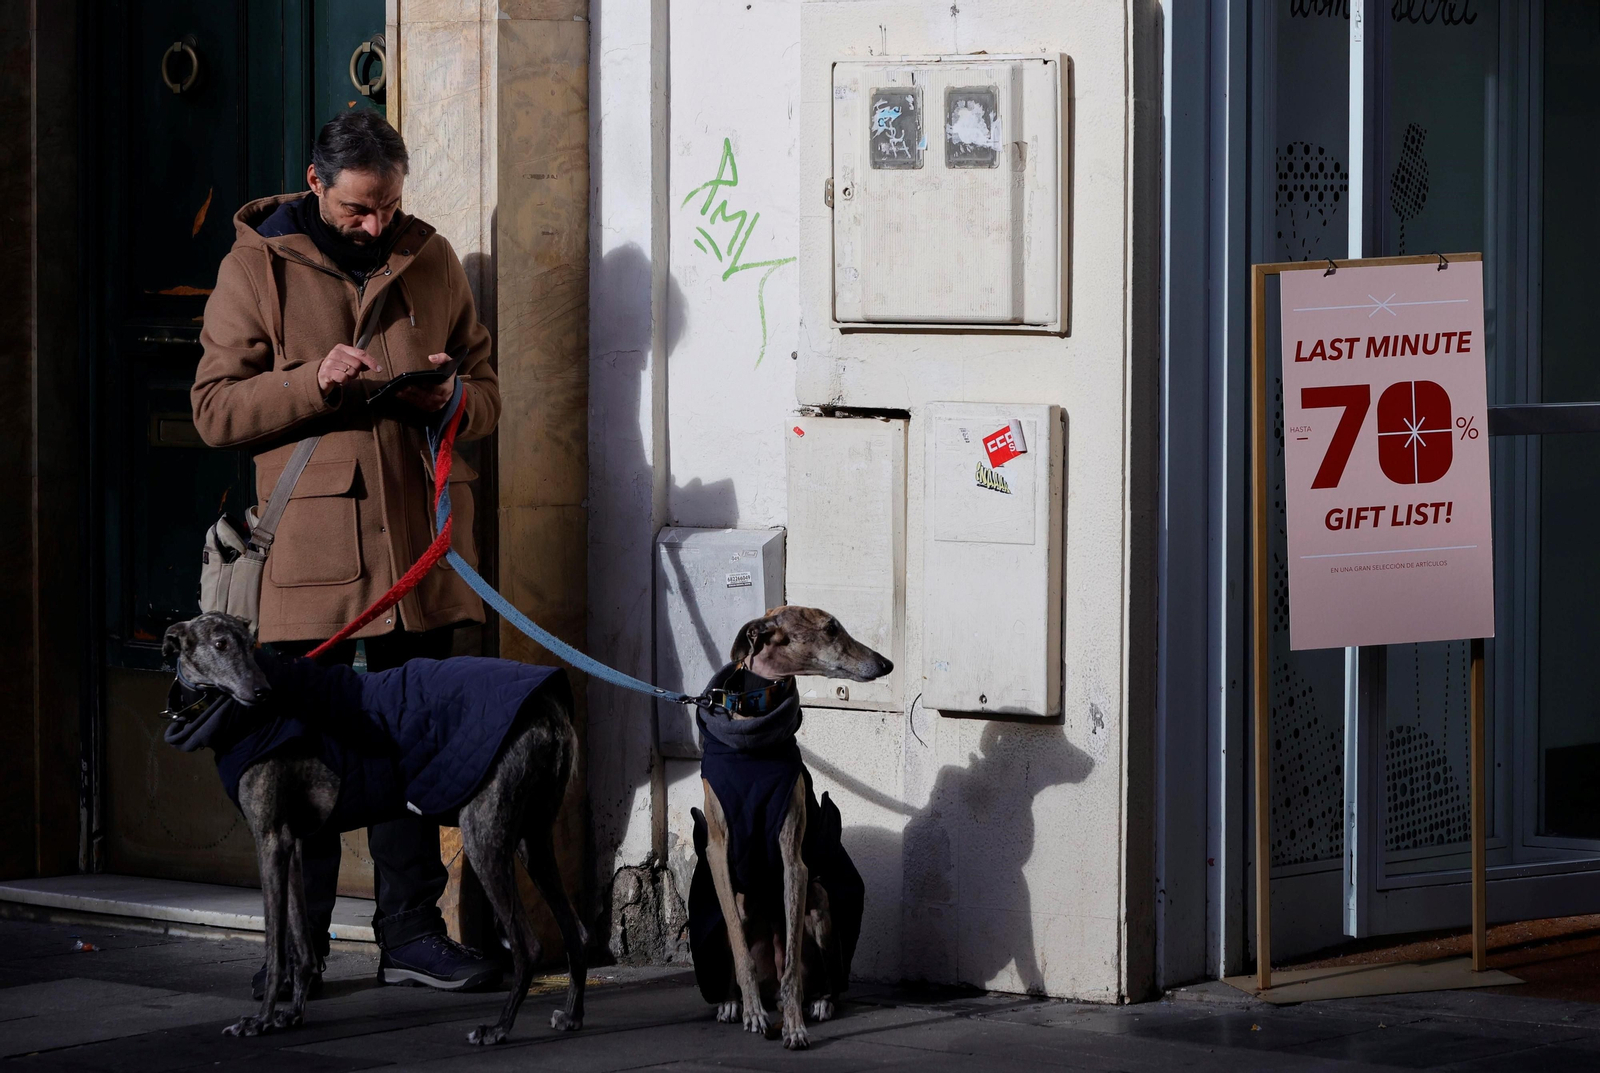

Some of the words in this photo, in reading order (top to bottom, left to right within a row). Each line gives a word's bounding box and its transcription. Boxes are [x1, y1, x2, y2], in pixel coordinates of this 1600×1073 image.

[1294, 336, 1361, 363] LAST
[1365, 330, 1473, 359] MINUTE
[1289, 425, 1312, 433] HASTA
[1324, 505, 1386, 532] GIFT
[1390, 501, 1454, 527] LIST!
[1354, 564, 1371, 572] GRAN
[1372, 562, 1405, 571] SELECCIÓN
[1416, 560, 1448, 569] ARTÍCULOS
